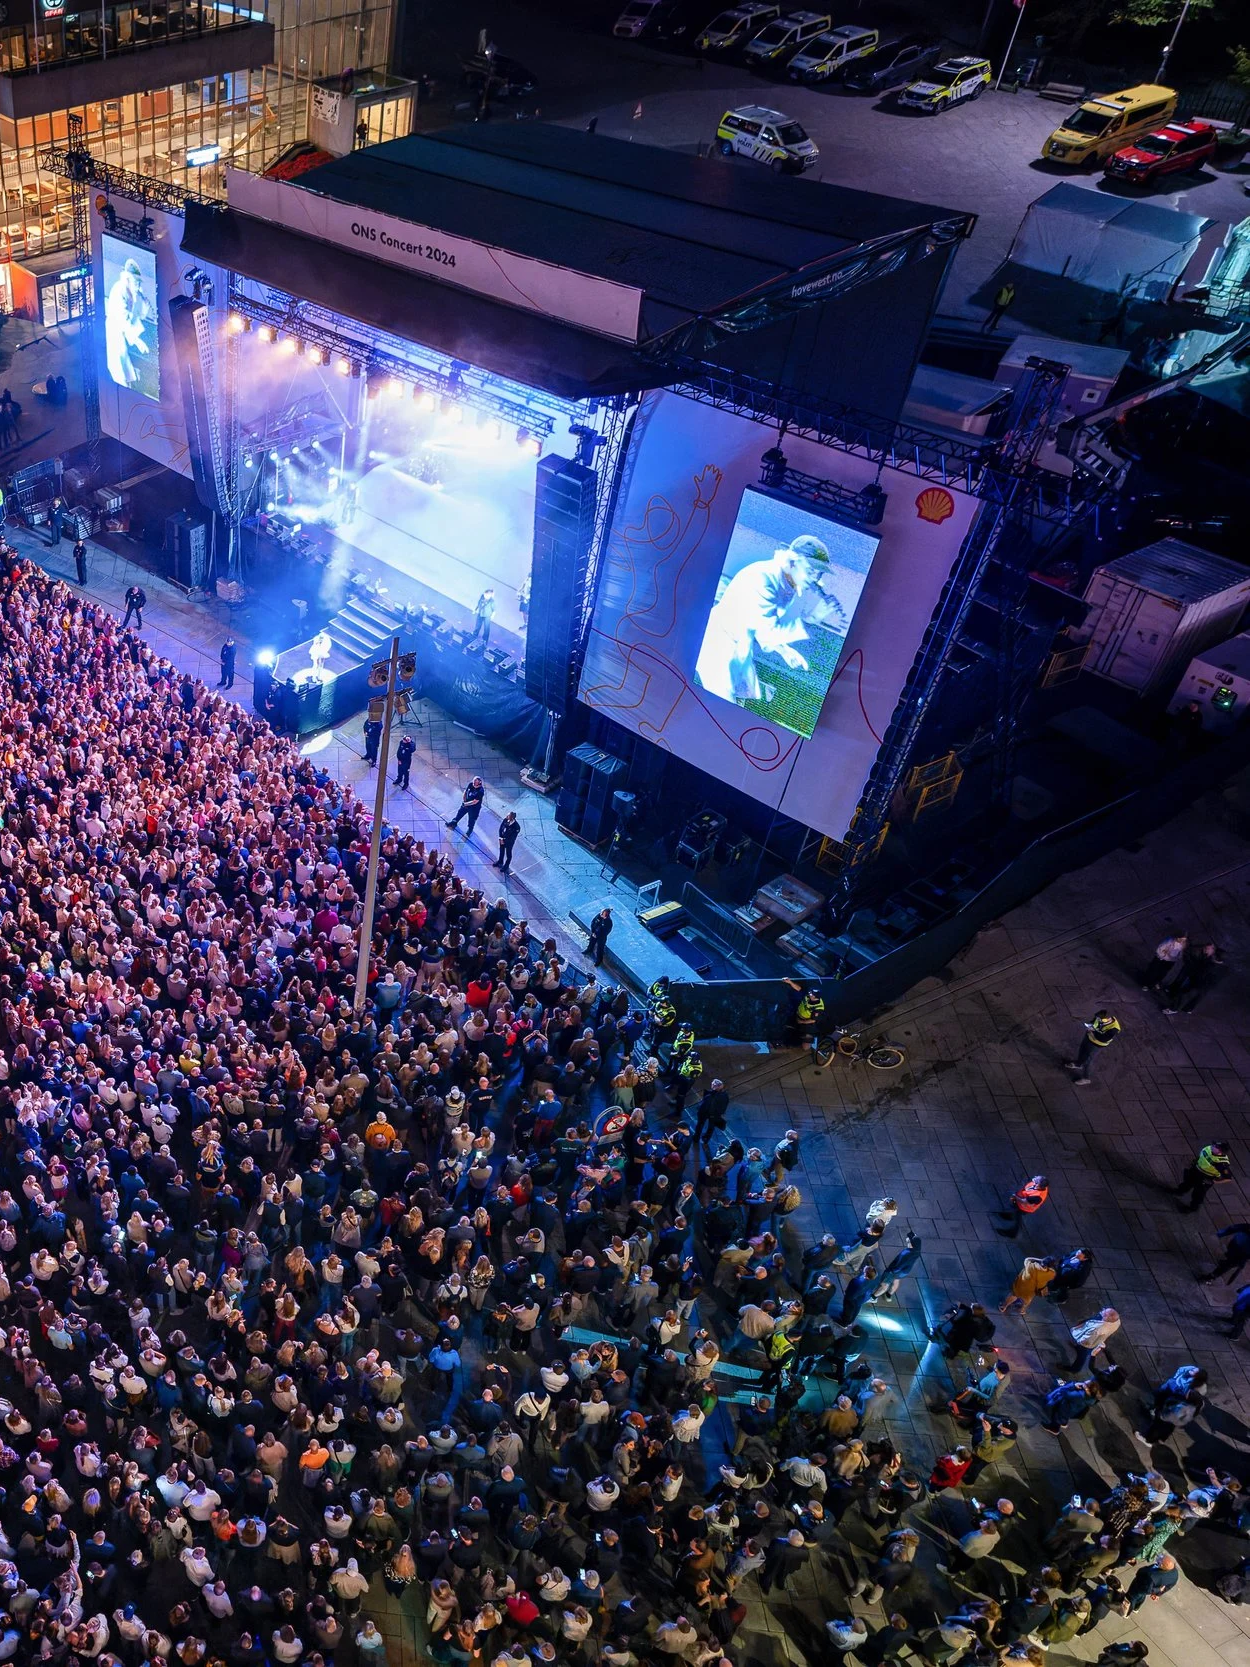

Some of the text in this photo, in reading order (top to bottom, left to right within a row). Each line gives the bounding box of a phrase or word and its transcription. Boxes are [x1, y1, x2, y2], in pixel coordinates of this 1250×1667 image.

[351, 222, 456, 267] ONS Concert 2024
[791, 270, 843, 298] hovewest.no
